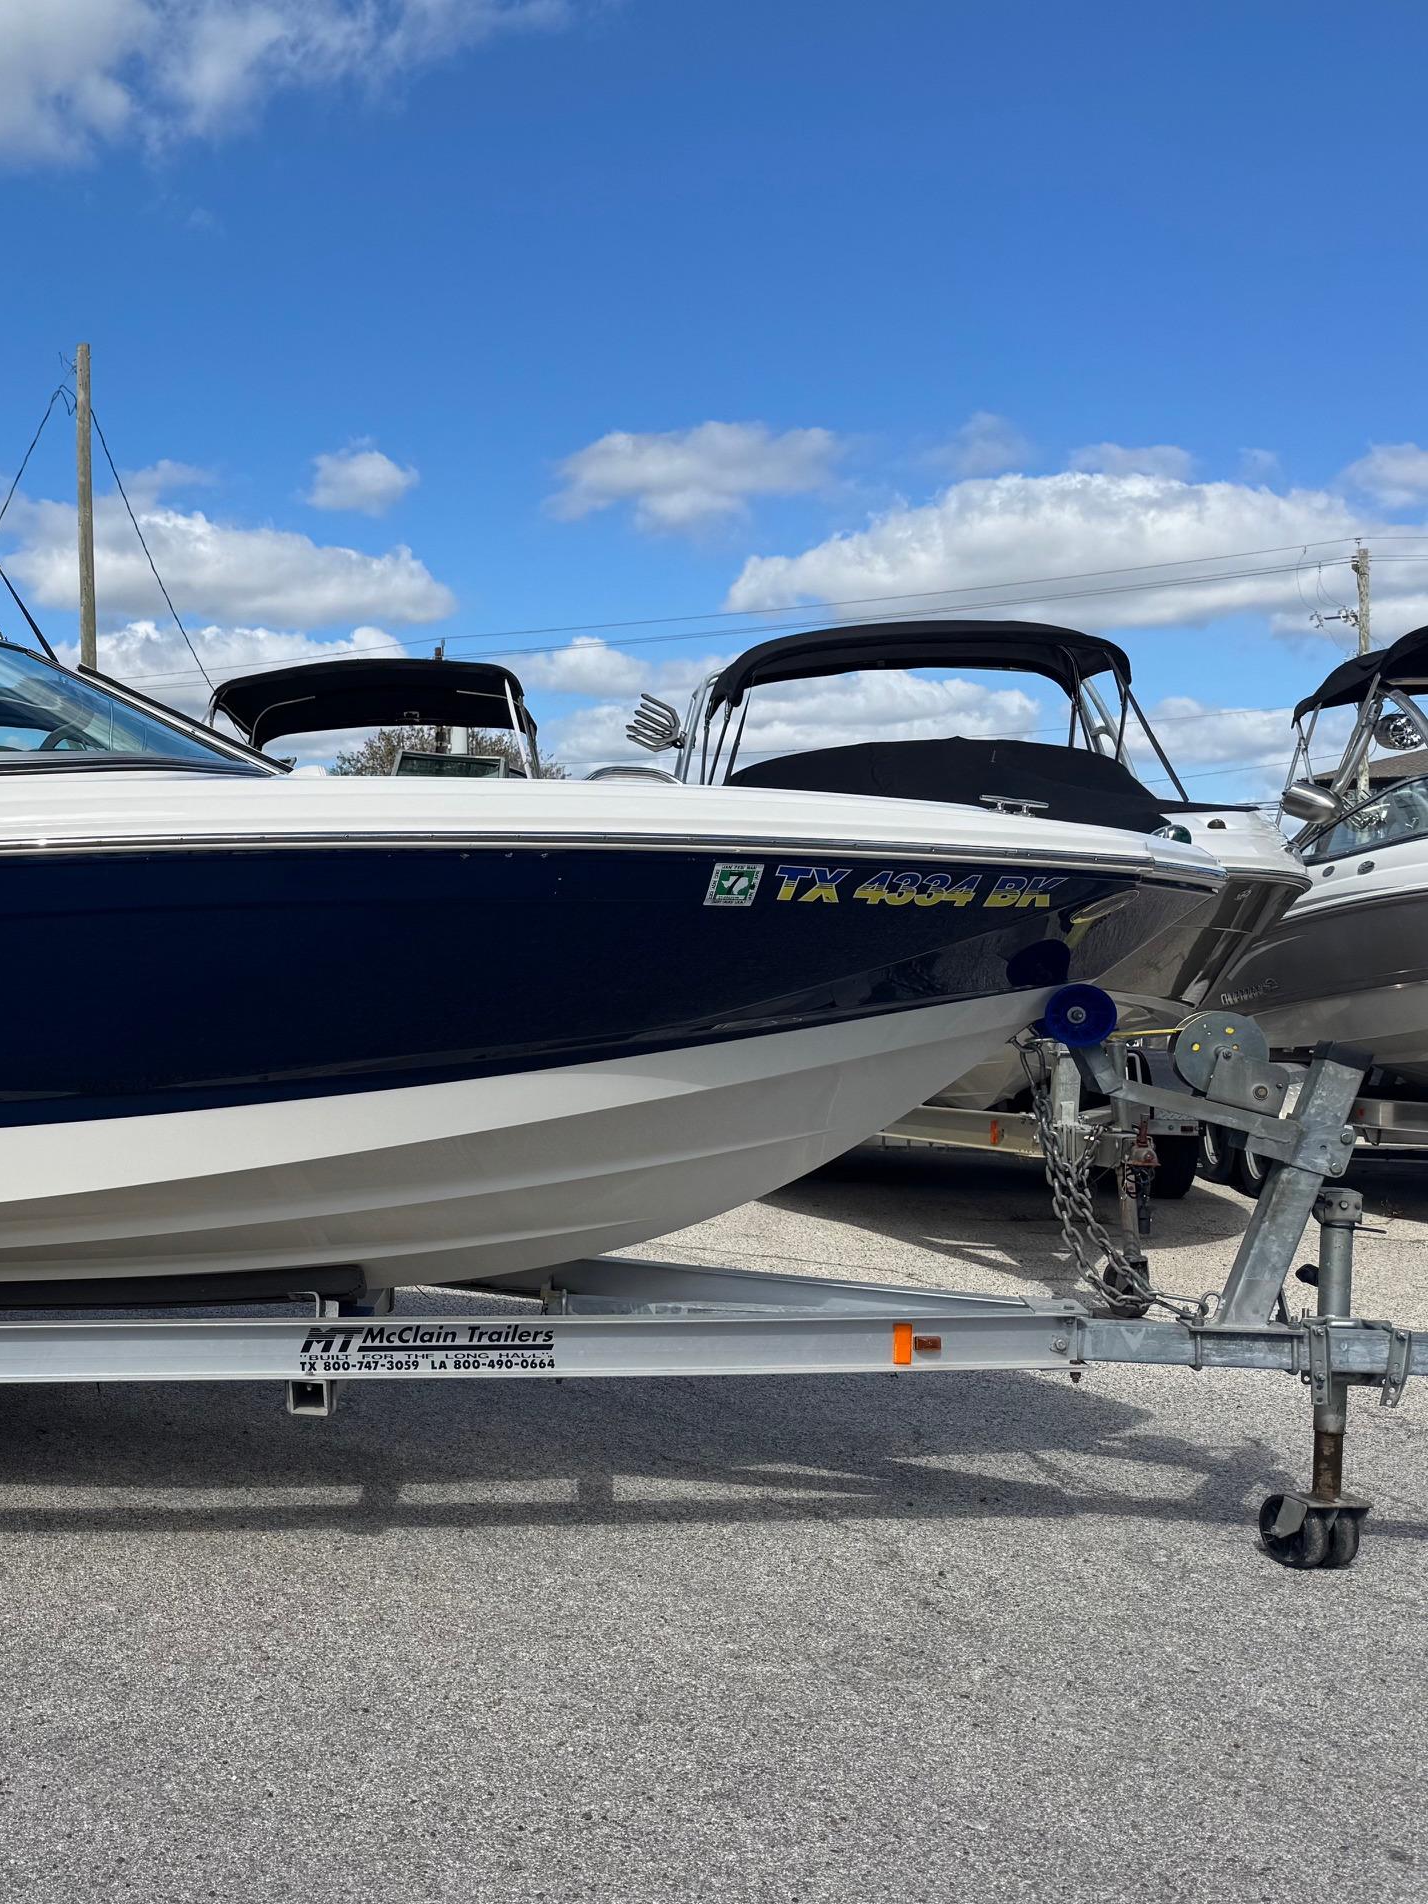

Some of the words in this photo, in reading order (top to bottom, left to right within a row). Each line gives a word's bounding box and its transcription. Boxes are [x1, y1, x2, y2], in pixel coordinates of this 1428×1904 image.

[775, 865, 852, 903] TX
[853, 870, 982, 907] 4334
[983, 876, 1069, 907] BK
[362, 1325, 458, 1344] McClain
[468, 1324, 555, 1343] Trailers
[300, 1361, 317, 1371] TX
[323, 1360, 420, 1371] 800-747-3059
[431, 1360, 448, 1370] LA
[454, 1358, 555, 1370] 800-490-0664
